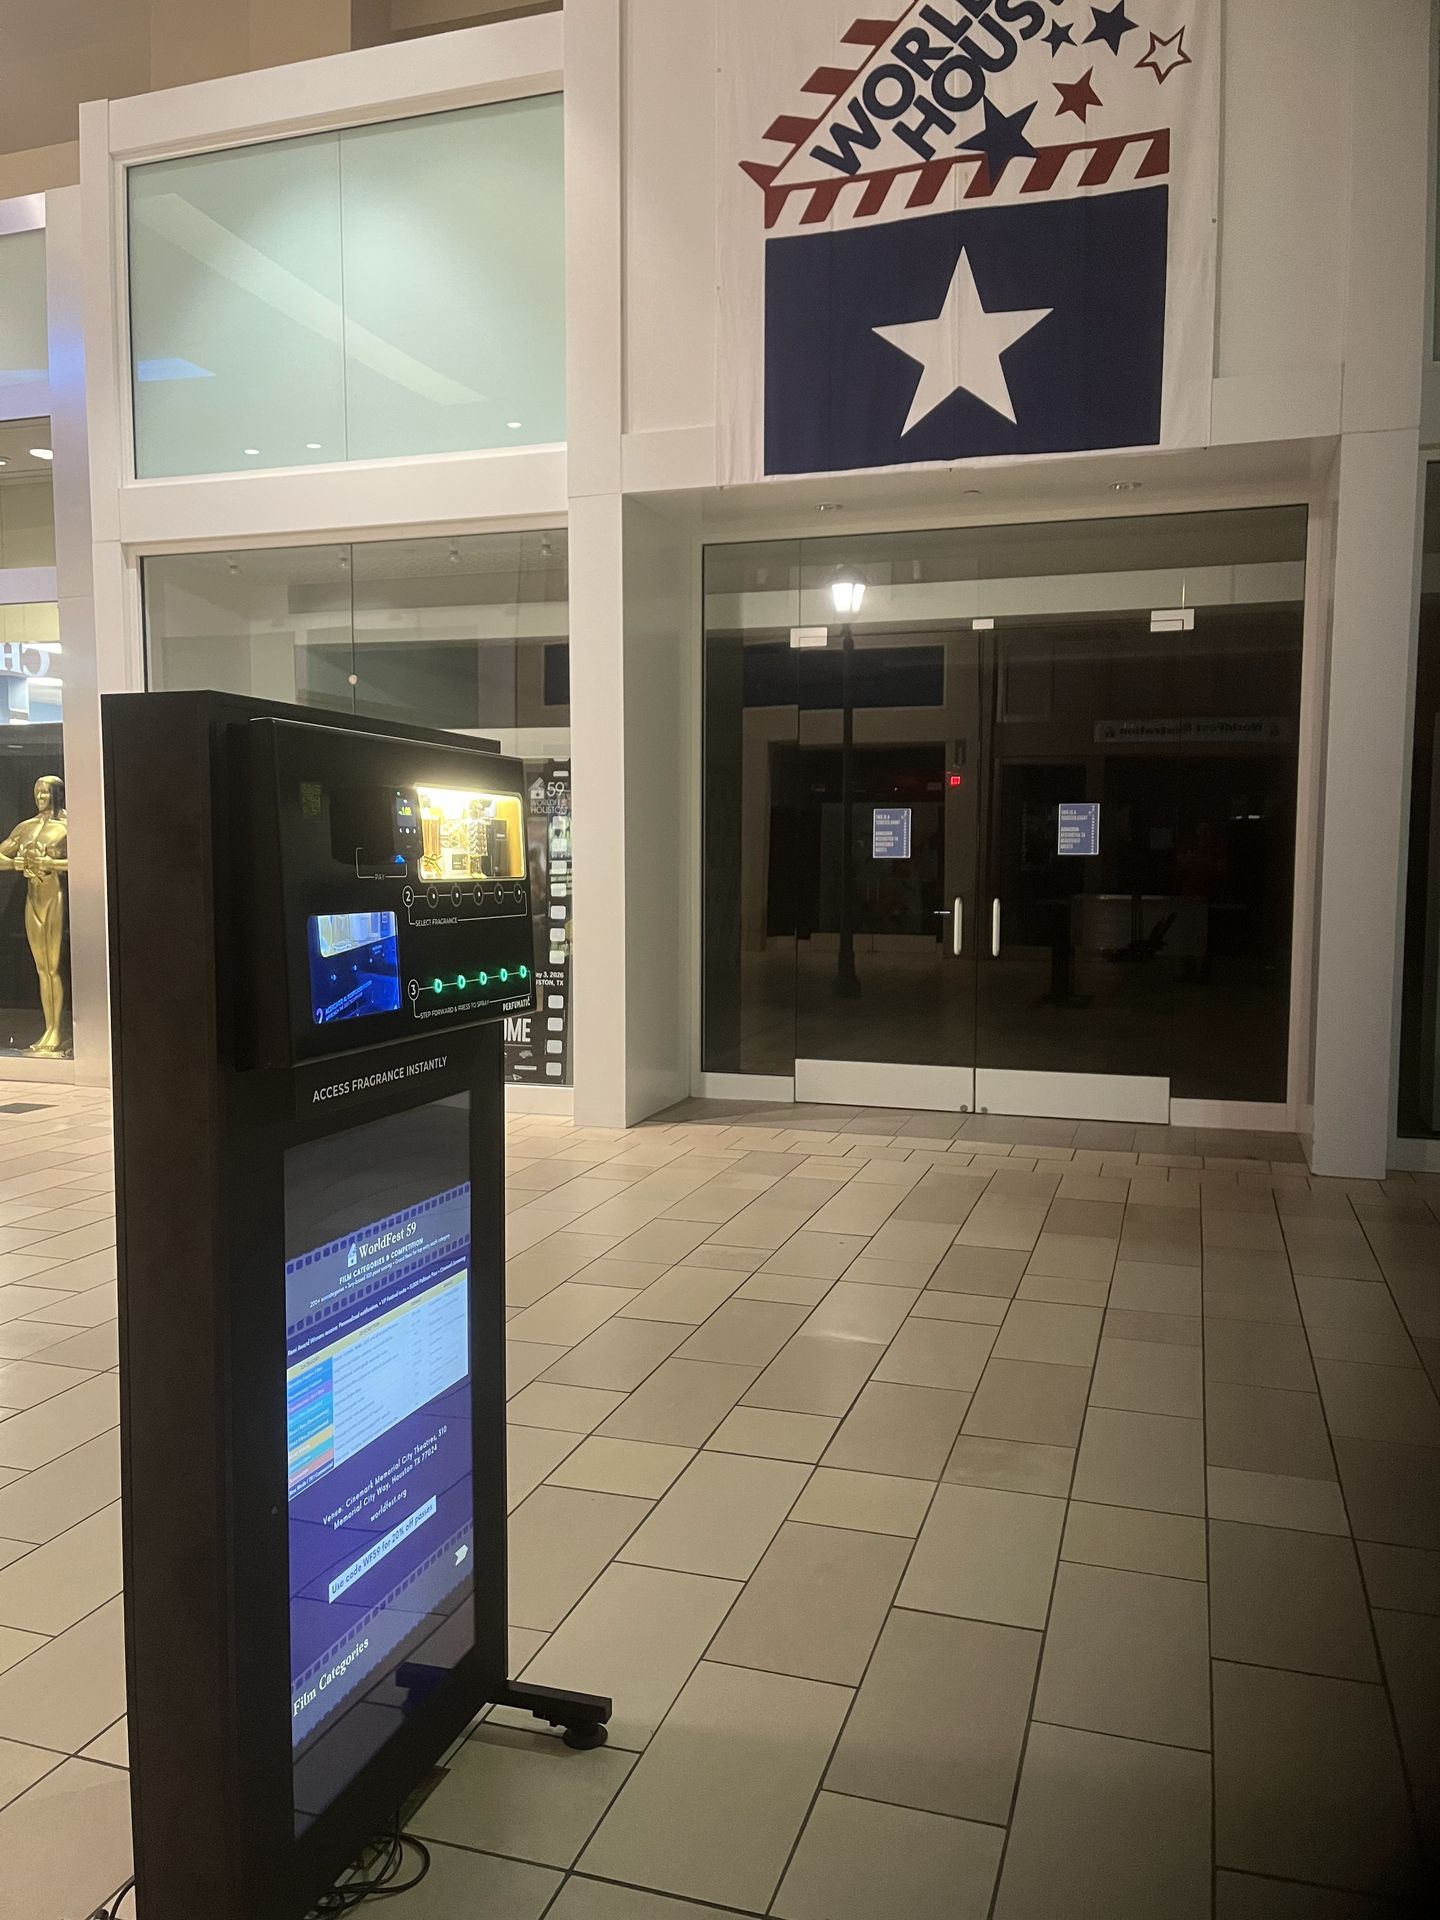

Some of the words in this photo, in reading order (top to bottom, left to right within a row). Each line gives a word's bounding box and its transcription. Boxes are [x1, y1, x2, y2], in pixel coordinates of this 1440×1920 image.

[892, 0, 1064, 161] HOUS
[546, 781, 565, 797] 59
[530, 805, 568, 815] HOUSTON
[405, 891, 411, 902] 2
[415, 918, 431, 927] SELECT
[432, 916, 458, 925] FRAGRANCE
[411, 984, 416, 996] 3
[420, 1010, 431, 1019] STEP
[432, 1005, 454, 1017] FORWARD
[458, 1002, 471, 1012] PRESS
[476, 999, 490, 1008] SPRAY
[312, 1081, 350, 1103] ACCESS
[352, 1066, 405, 1092] FRAGRANCE
[406, 1055, 448, 1077] INSTANTLY
[359, 1228, 405, 1259] WorldFest
[406, 1221, 417, 1238] 59
[339, 1272, 352, 1285] FILM
[352, 1256, 385, 1278] CATEGORIES
[390, 1237, 424, 1259] COMPETITION
[322, 1504, 344, 1525] Venue:
[345, 1479, 374, 1508] Cinemark
[374, 1458, 401, 1486] Memorial
[401, 1451, 413, 1464] City
[333, 1500, 362, 1530] Memorial
[363, 1492, 376, 1506] City
[376, 1482, 391, 1496] Way,
[391, 1463, 413, 1485] Houston
[413, 1457, 421, 1467] TX
[421, 1443, 438, 1463] 77024
[370, 1489, 407, 1522] worldfest.org
[331, 1580, 345, 1594] Use
[345, 1563, 362, 1583] code
[362, 1545, 381, 1567] WF59
[380, 1539, 391, 1552] for
[391, 1528, 405, 1543] 20%
[405, 1518, 415, 1531] off
[414, 1504, 433, 1526] passes
[293, 1687, 317, 1717] Film
[318, 1637, 369, 1691] Categories
